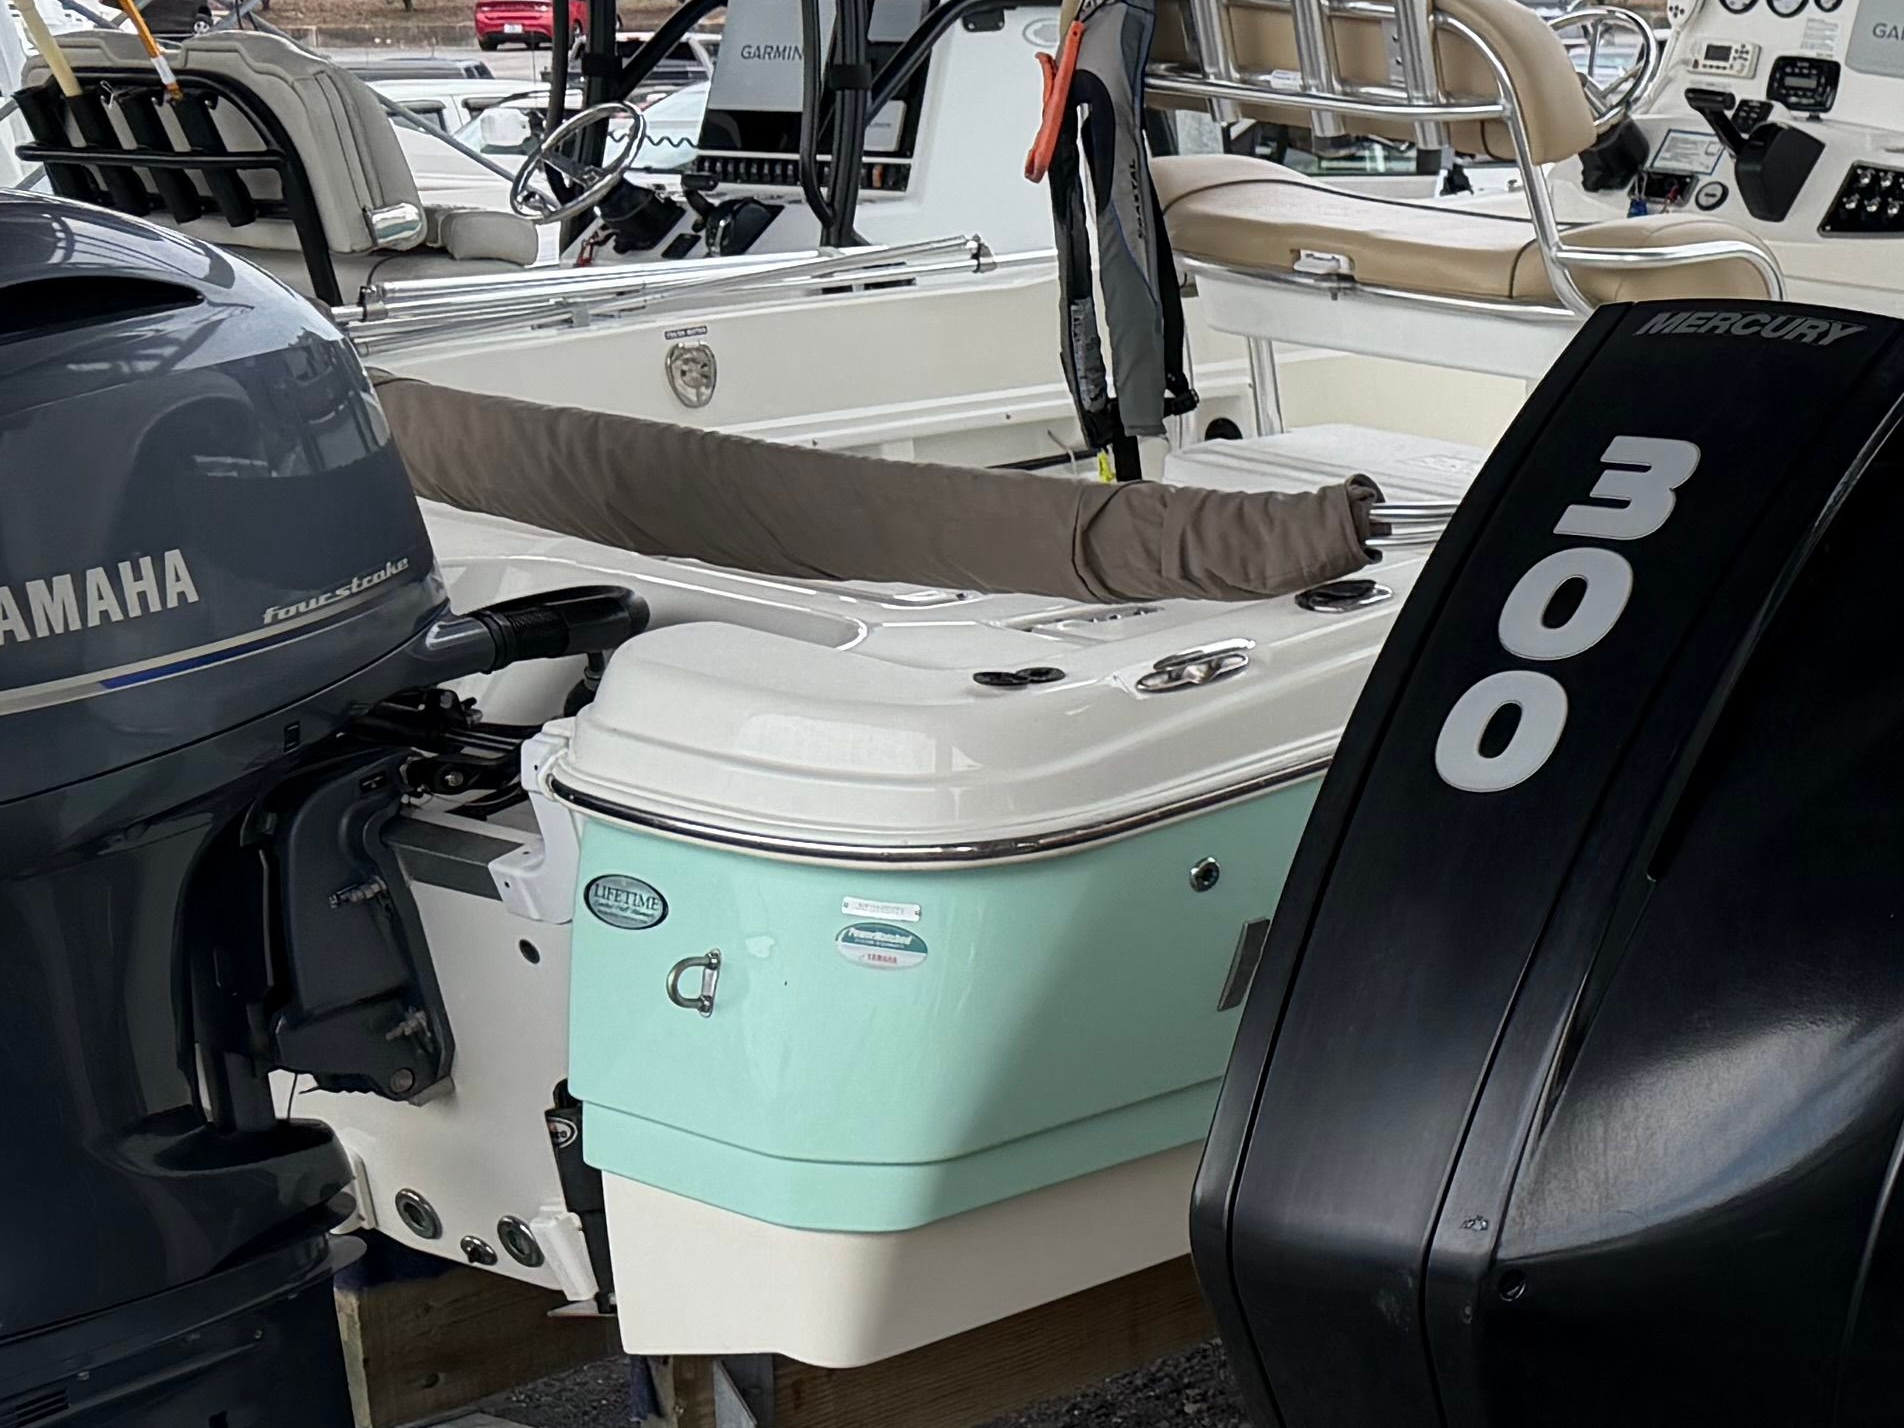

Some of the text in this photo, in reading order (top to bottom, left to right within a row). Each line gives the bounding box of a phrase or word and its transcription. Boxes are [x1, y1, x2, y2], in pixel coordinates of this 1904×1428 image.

[740, 43, 803, 61] GARMIN
[1631, 310, 1868, 347] MERCURY
[1434, 434, 1701, 794] 300
[593, 883, 661, 912] LIFETIME
